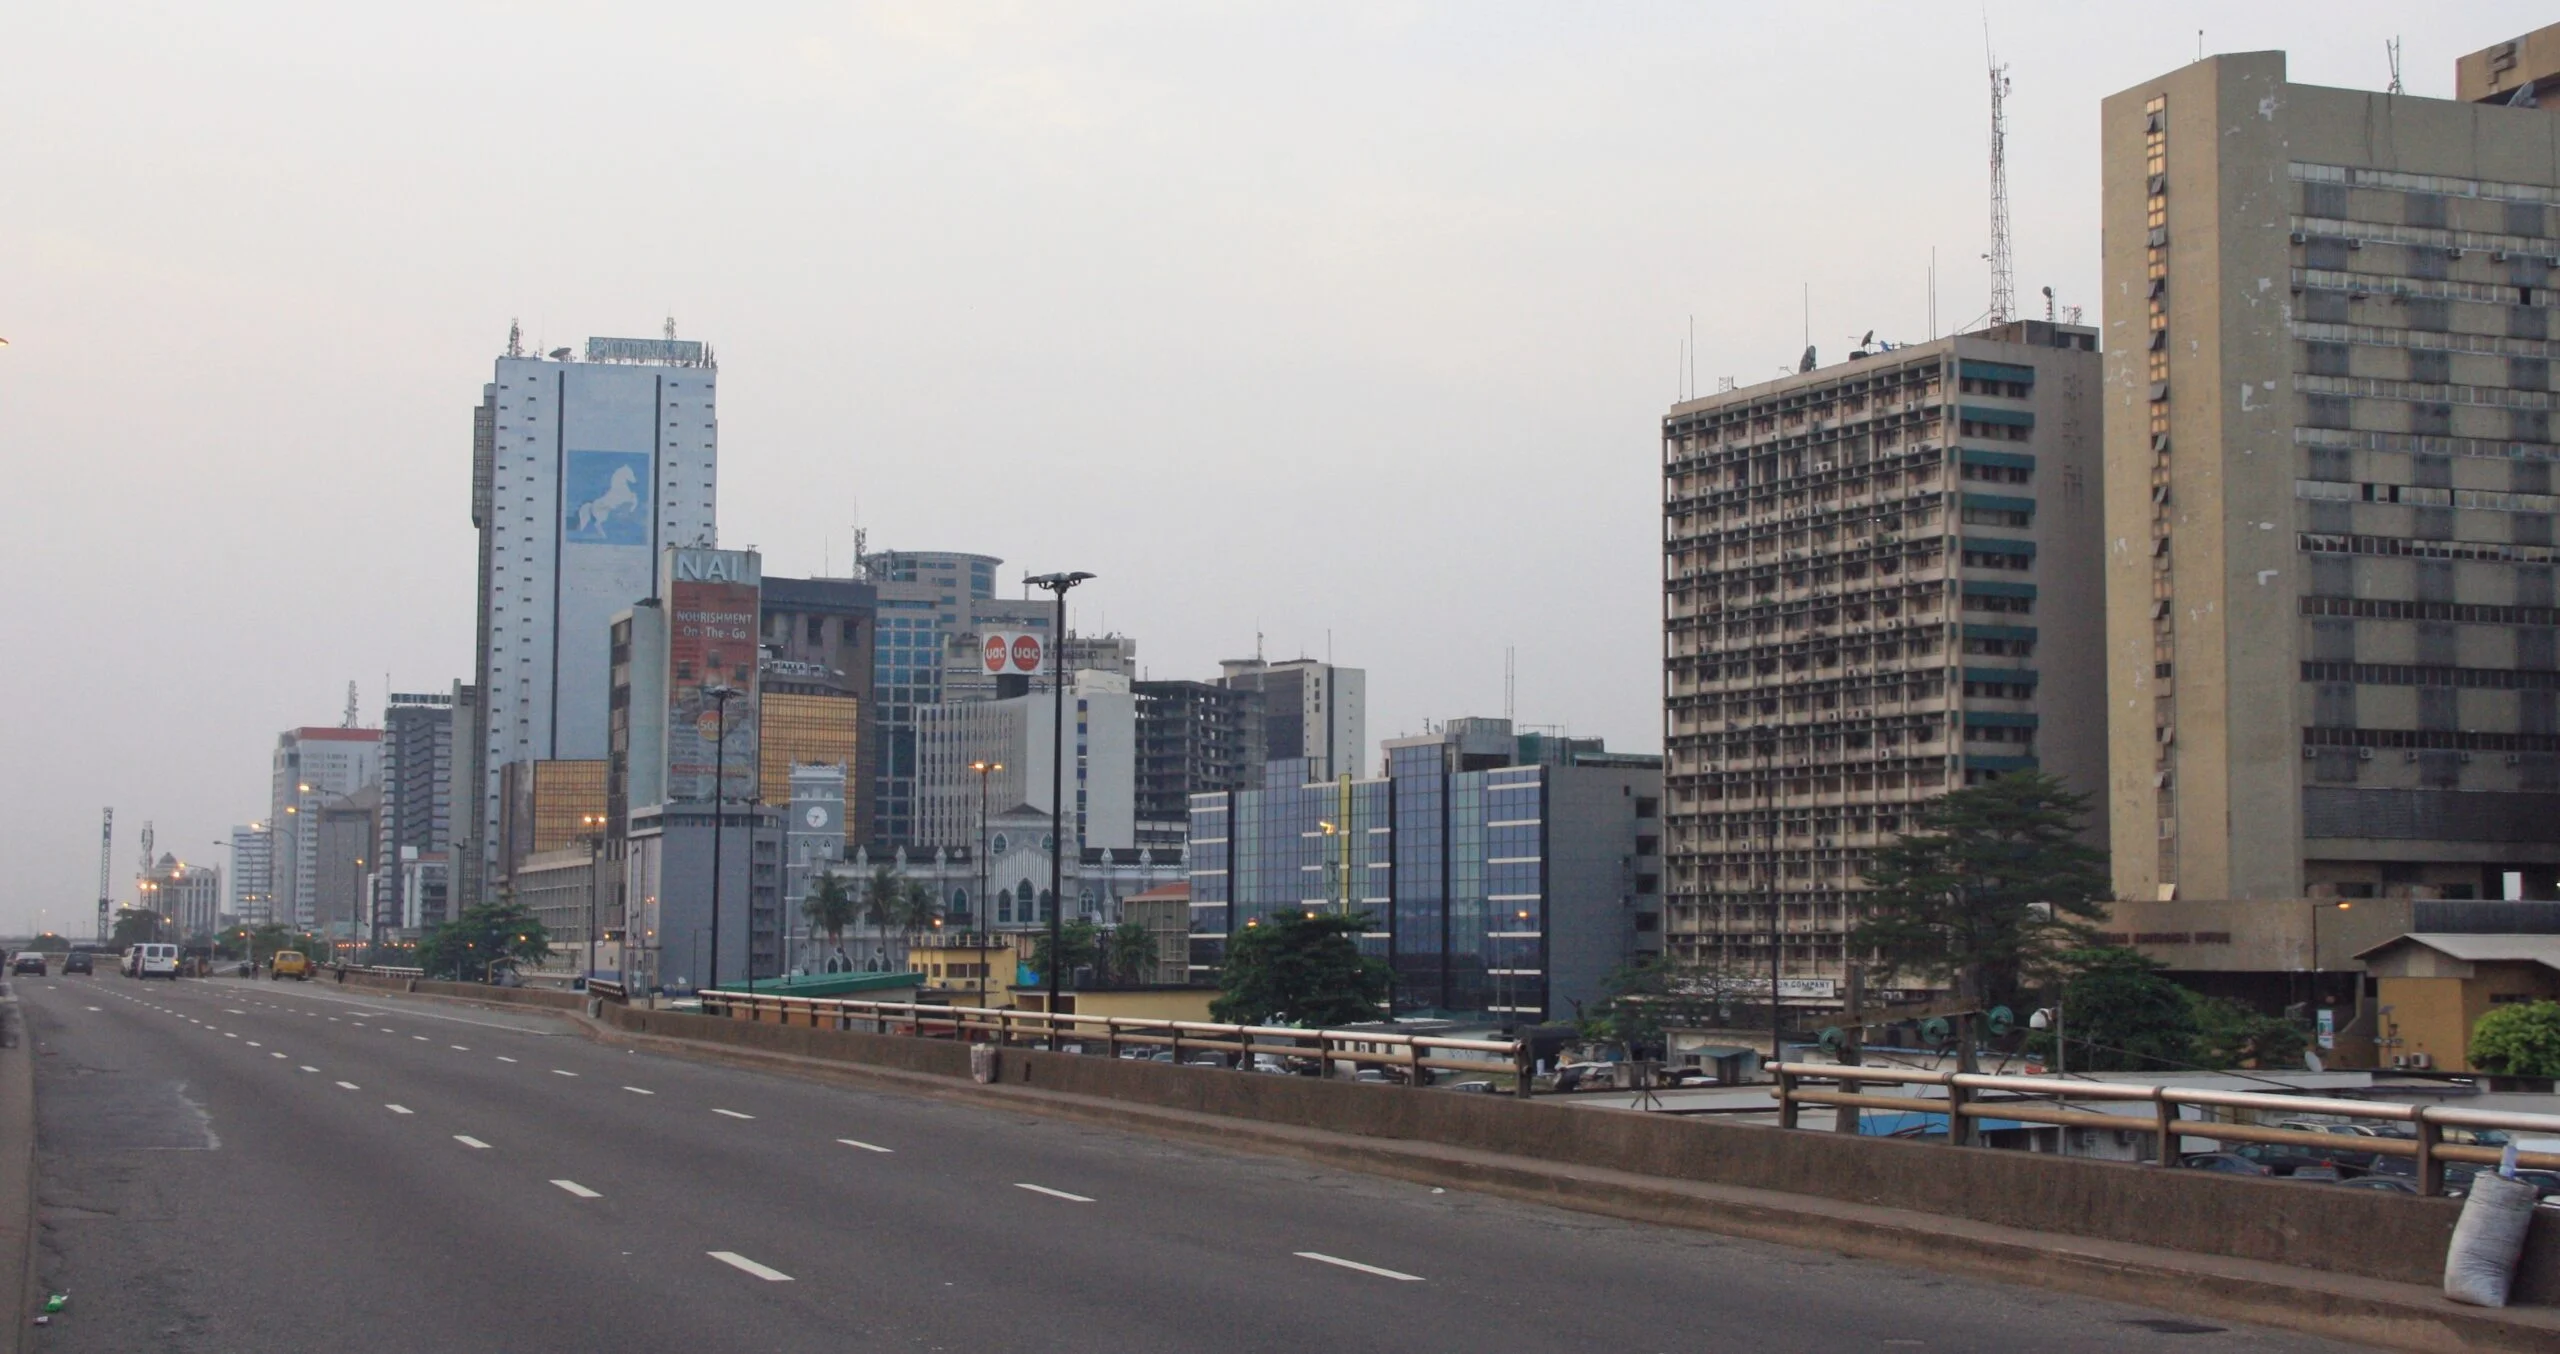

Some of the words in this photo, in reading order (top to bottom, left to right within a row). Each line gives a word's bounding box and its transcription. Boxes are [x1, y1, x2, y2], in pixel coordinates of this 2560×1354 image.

[676, 611, 753, 624] NOURISHMENT
[683, 625, 698, 636] On
[705, 626, 724, 638] The
[732, 628, 746, 639] Go
[985, 647, 1005, 660] uac
[1013, 646, 1039, 659] uac
